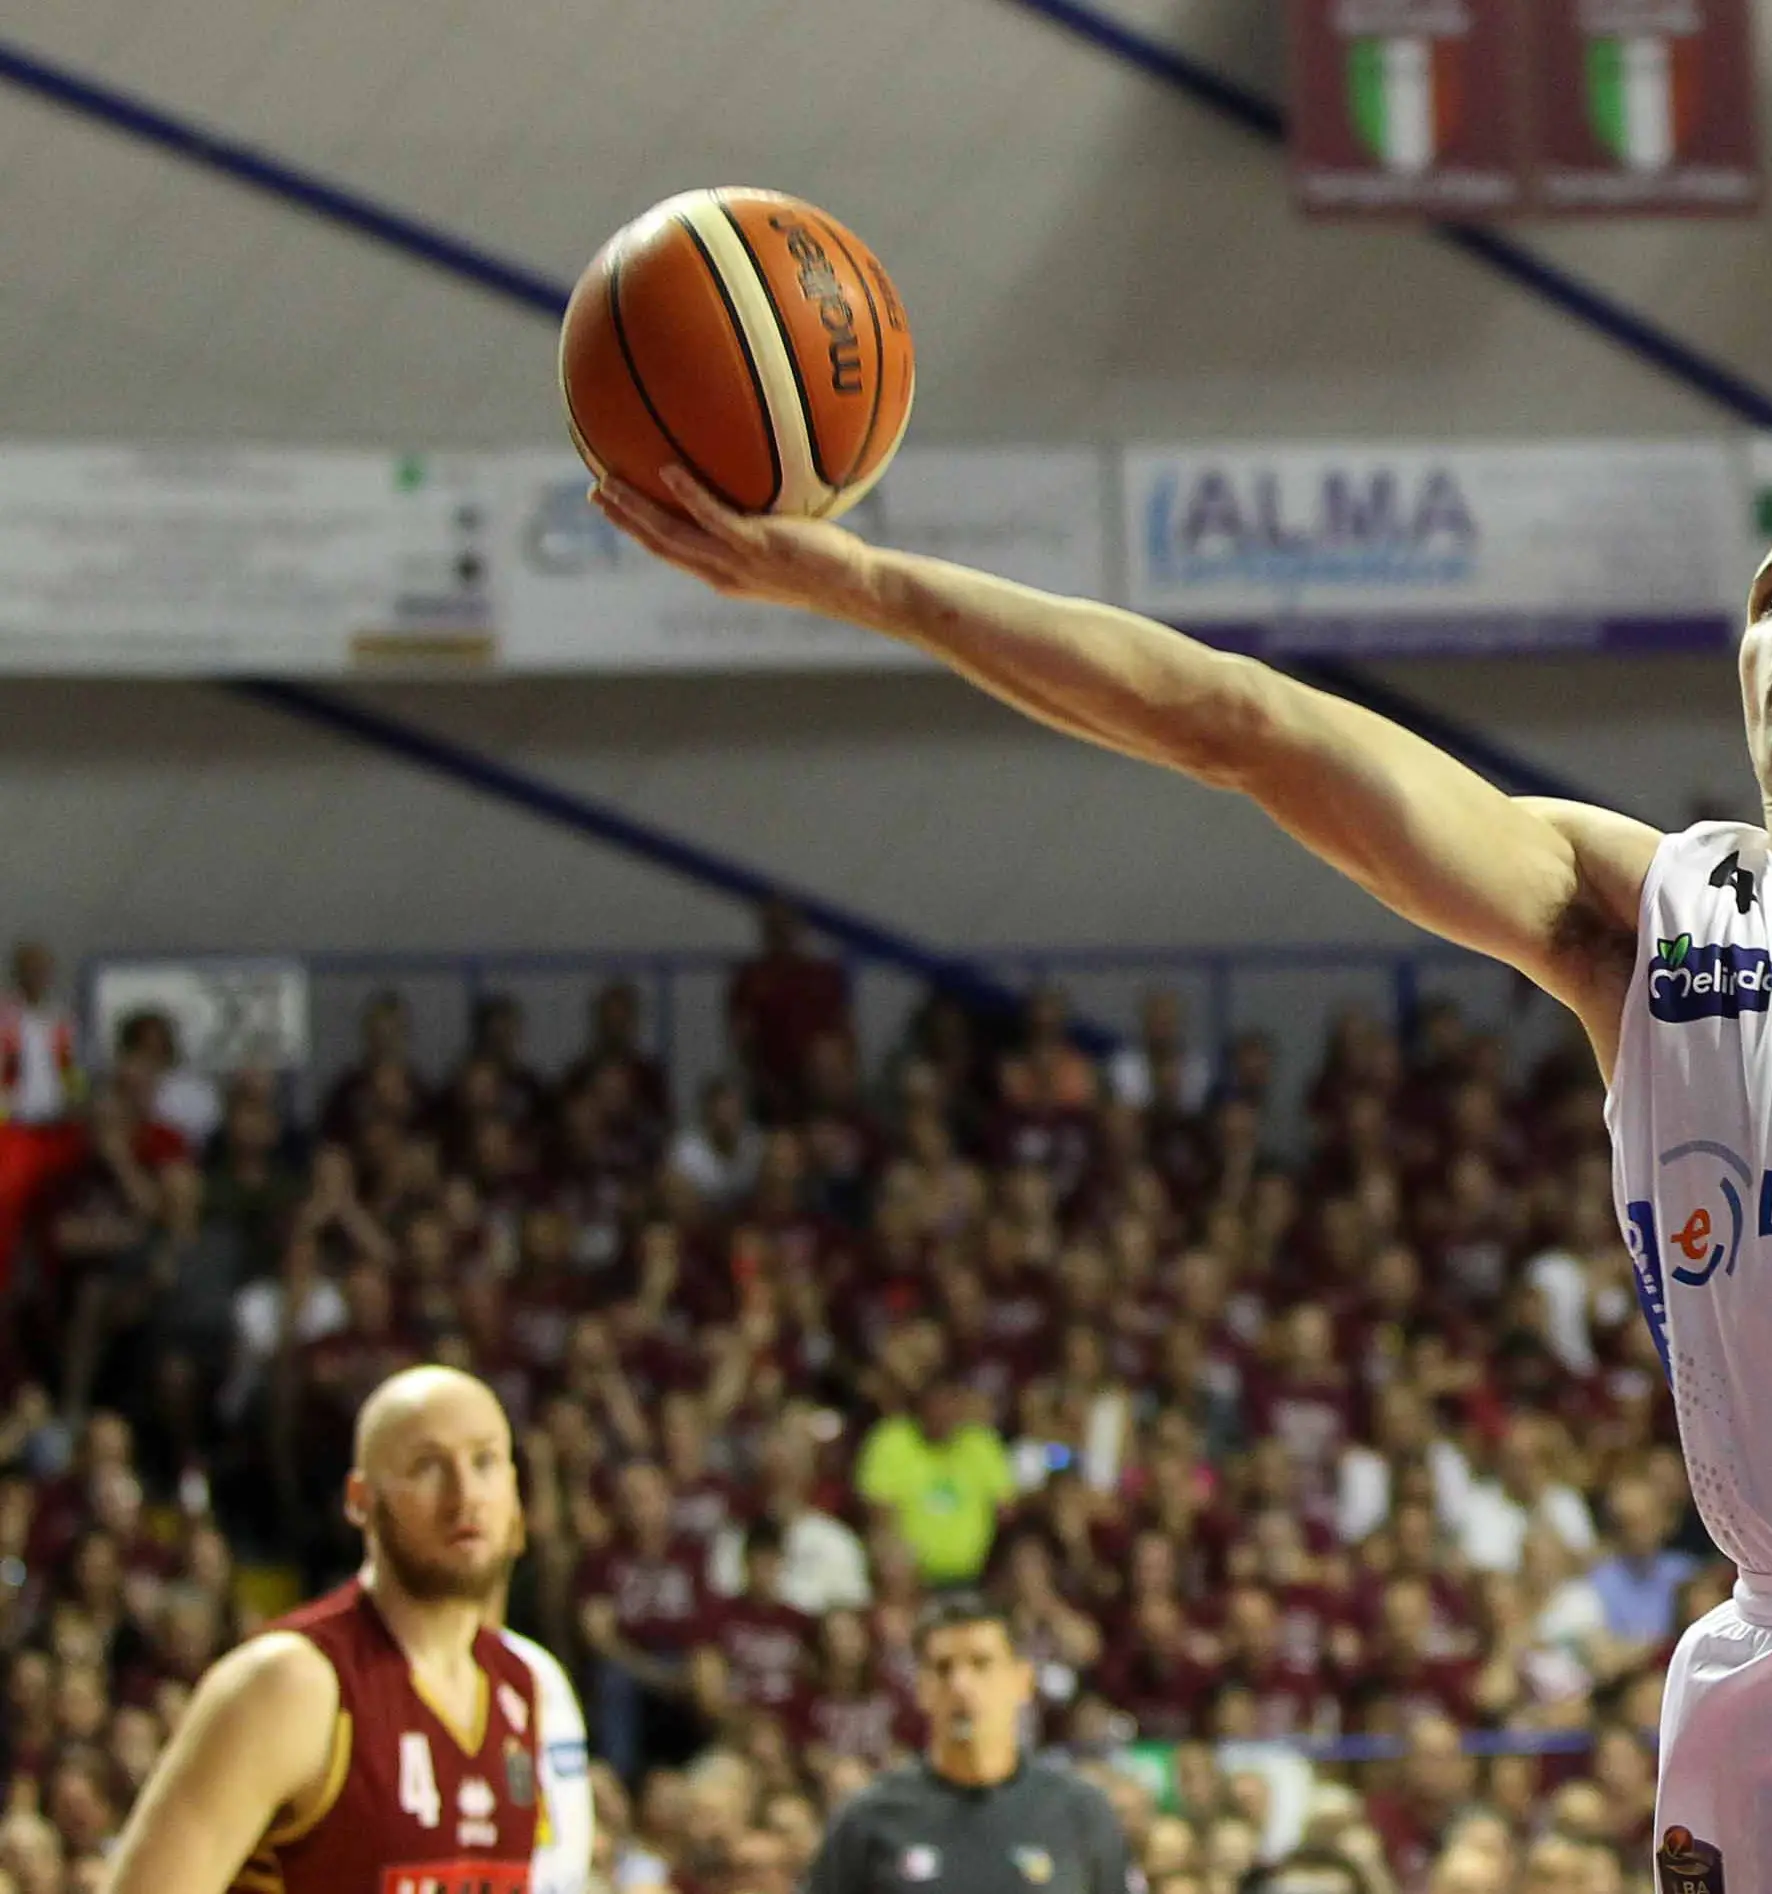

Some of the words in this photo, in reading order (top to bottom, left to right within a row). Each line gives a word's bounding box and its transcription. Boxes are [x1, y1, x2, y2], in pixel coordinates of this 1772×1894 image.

[1181, 465, 1480, 555] ALMA
[1708, 850, 1761, 914] 4
[399, 1731, 442, 1829] 4
